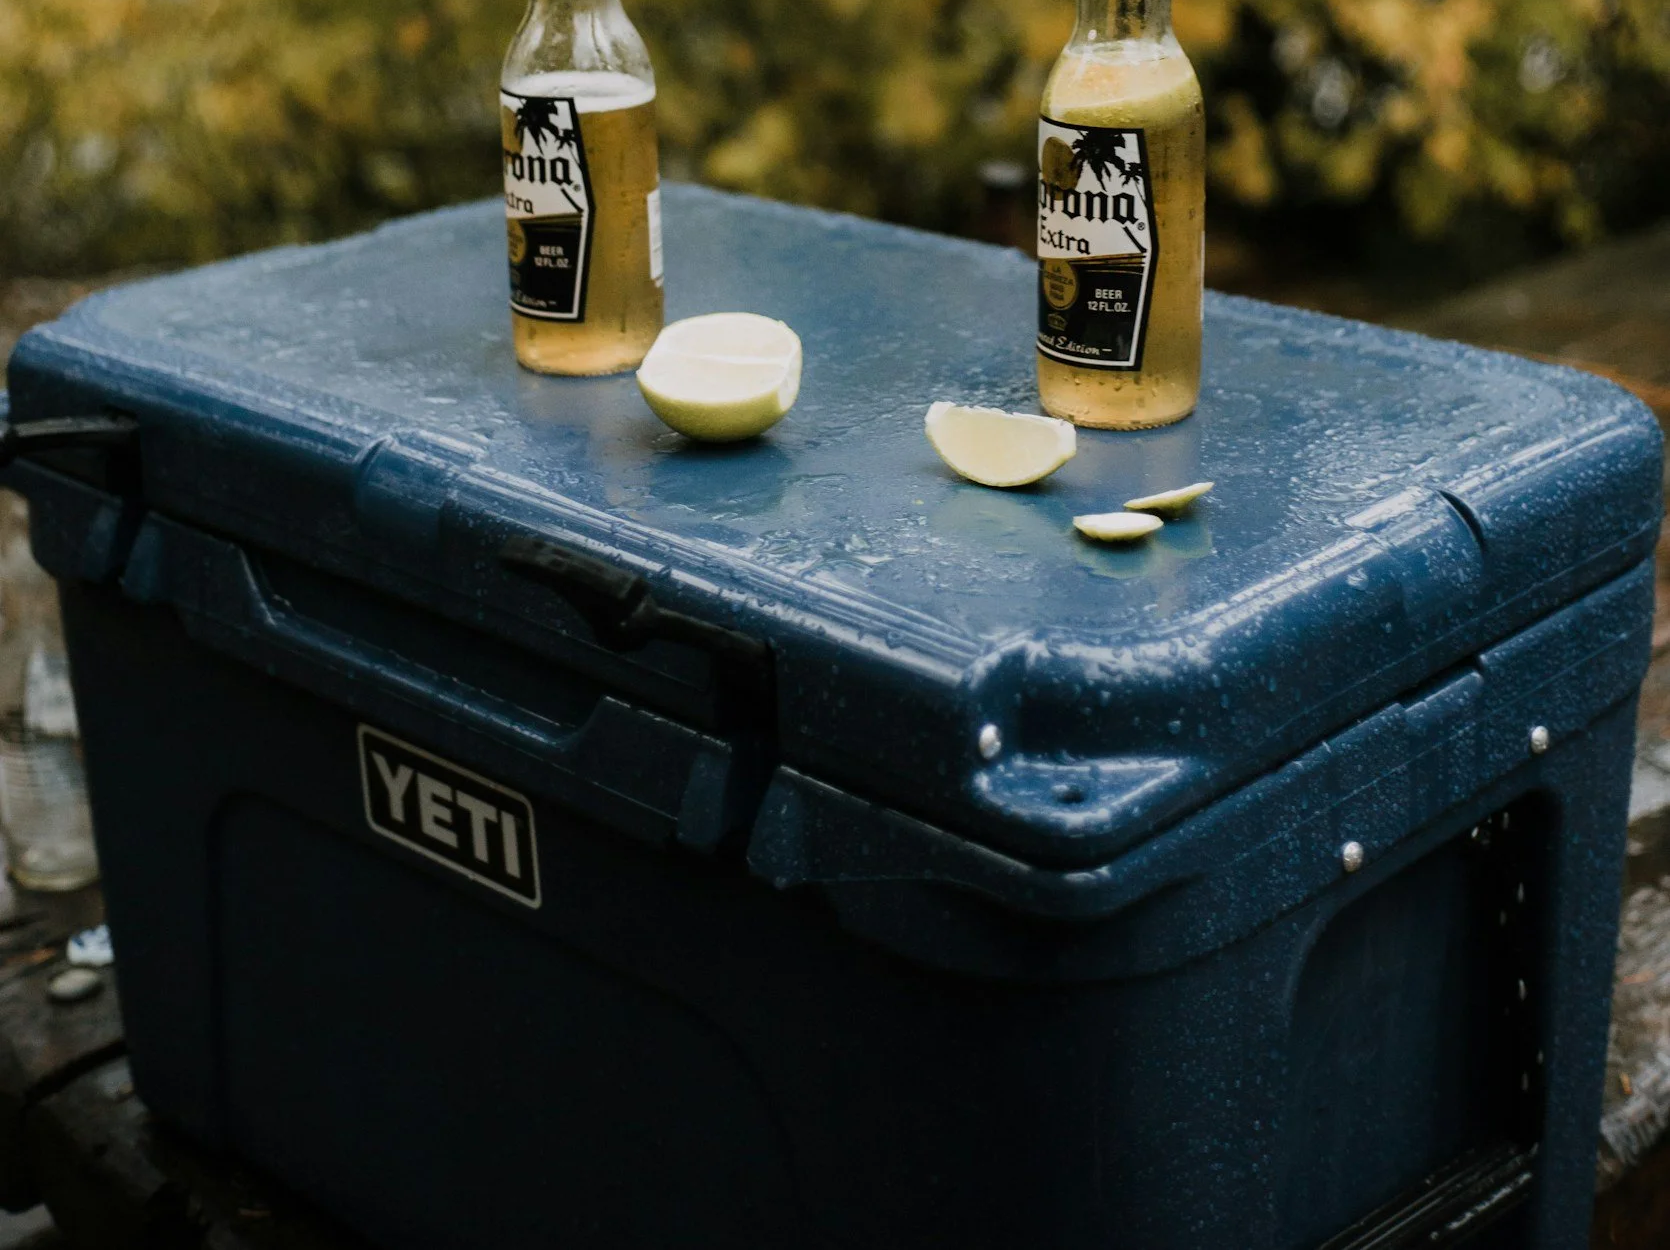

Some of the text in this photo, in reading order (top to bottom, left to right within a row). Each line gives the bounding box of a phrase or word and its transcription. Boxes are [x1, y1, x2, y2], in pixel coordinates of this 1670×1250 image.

[1039, 179, 1139, 225] orona
[1040, 214, 1091, 255] Extra
[1095, 288, 1123, 300] BEER
[369, 750, 521, 879] YETI
